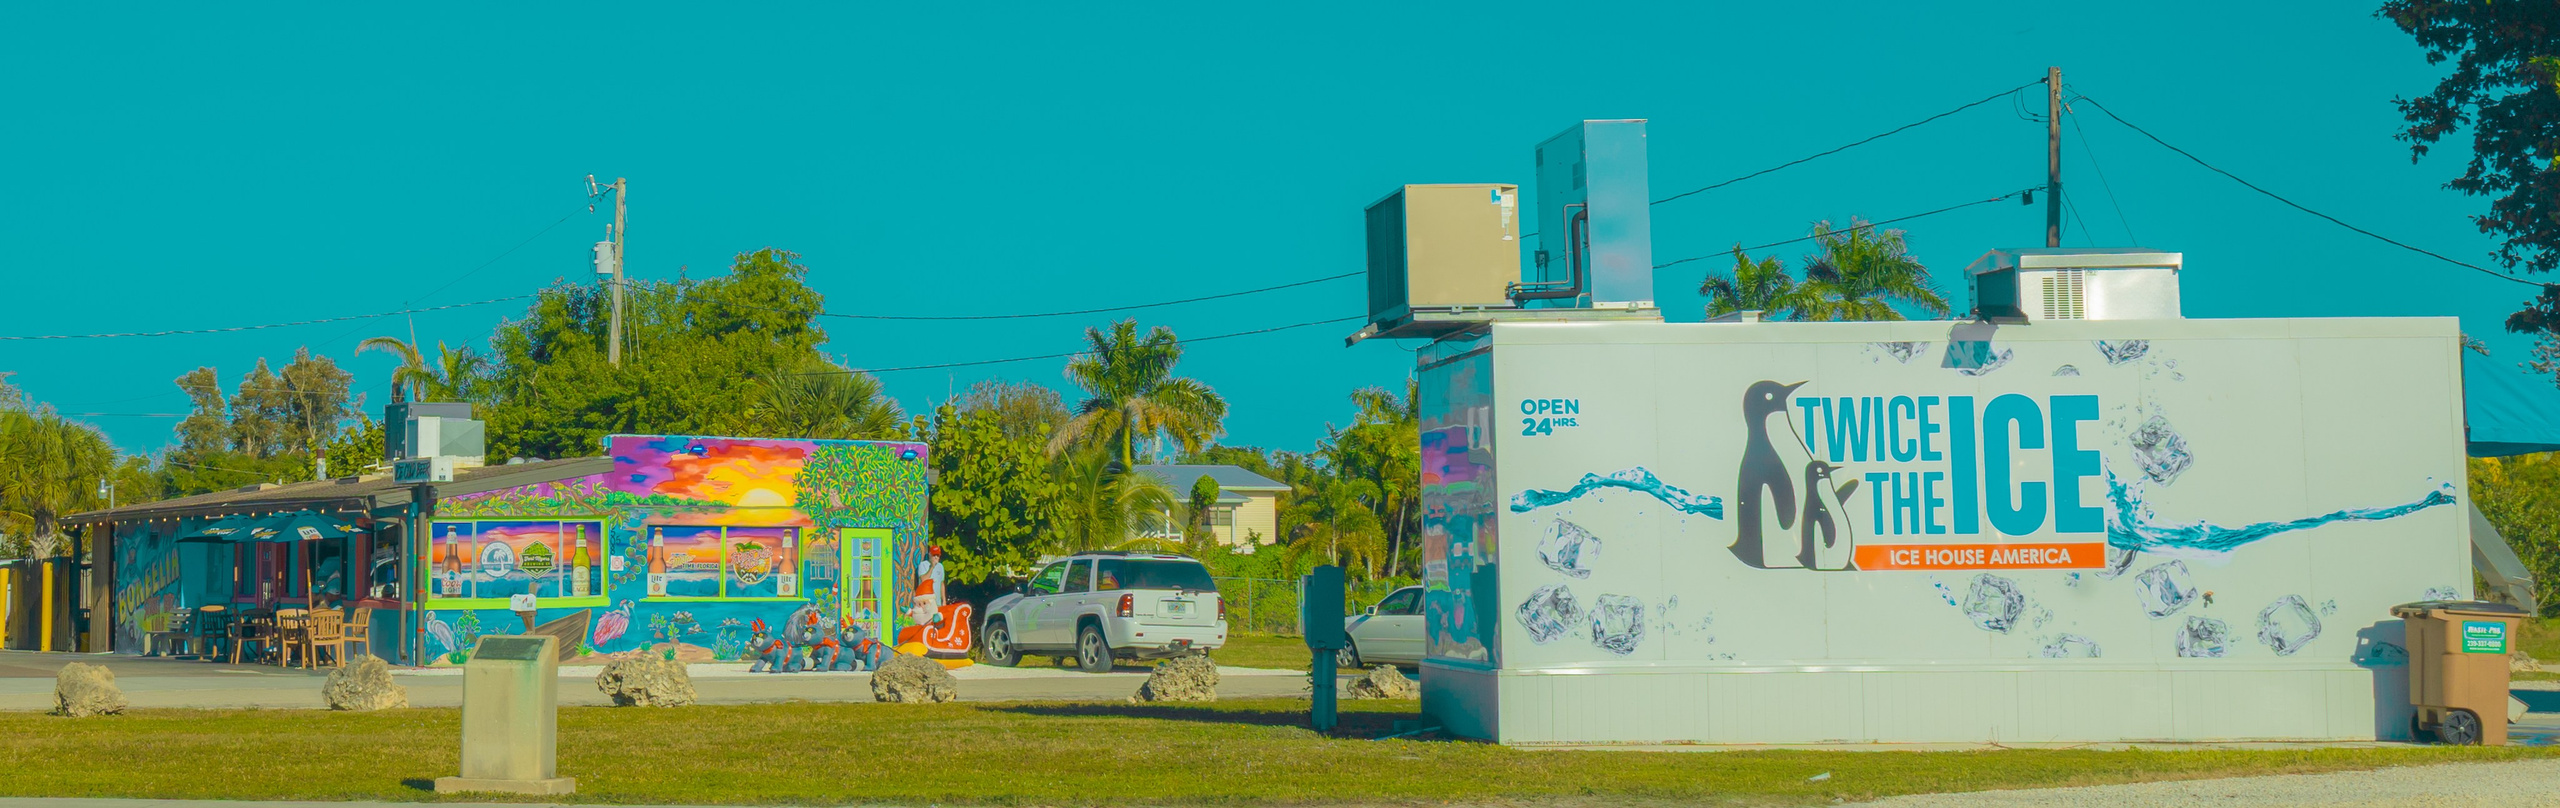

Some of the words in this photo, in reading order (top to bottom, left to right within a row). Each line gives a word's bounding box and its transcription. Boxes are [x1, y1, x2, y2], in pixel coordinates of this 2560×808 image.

[1521, 398, 1579, 415] OPEN
[1522, 417, 1553, 436] 24
[1553, 417, 1580, 427] HRS.
[1796, 395, 1943, 462] TWICE
[1948, 393, 2105, 536] ICE
[1865, 471, 1946, 535] THE
[1890, 550, 1920, 566] ICE
[1925, 549, 1985, 566] HOUSE
[1989, 548, 2072, 565] AMERICA
